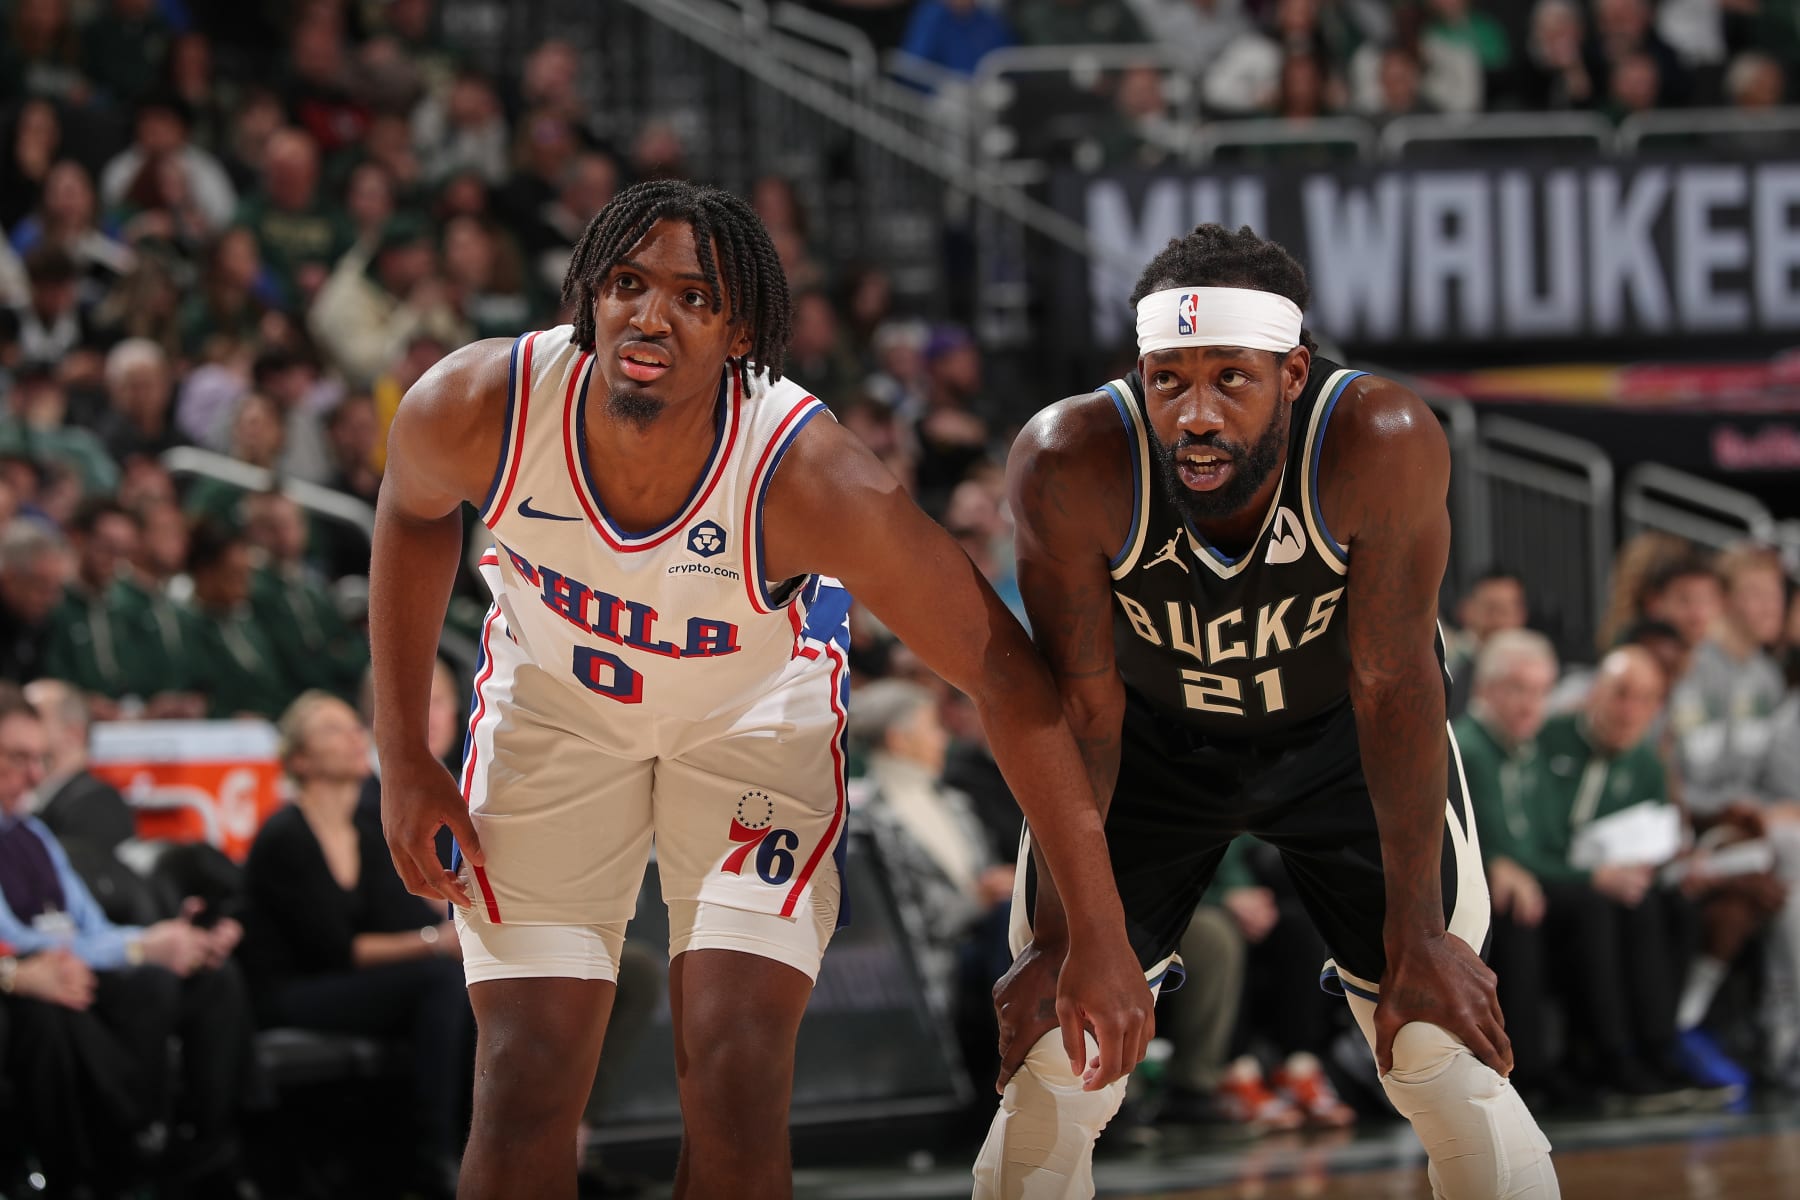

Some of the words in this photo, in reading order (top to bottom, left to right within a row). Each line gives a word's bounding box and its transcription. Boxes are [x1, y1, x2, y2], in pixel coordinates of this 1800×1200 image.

[668, 563, 740, 580] crypto.com
[1114, 586, 1346, 666] BUCKS
[572, 645, 643, 704] 0
[1179, 667, 1287, 716] 21
[720, 817, 799, 885] 76
